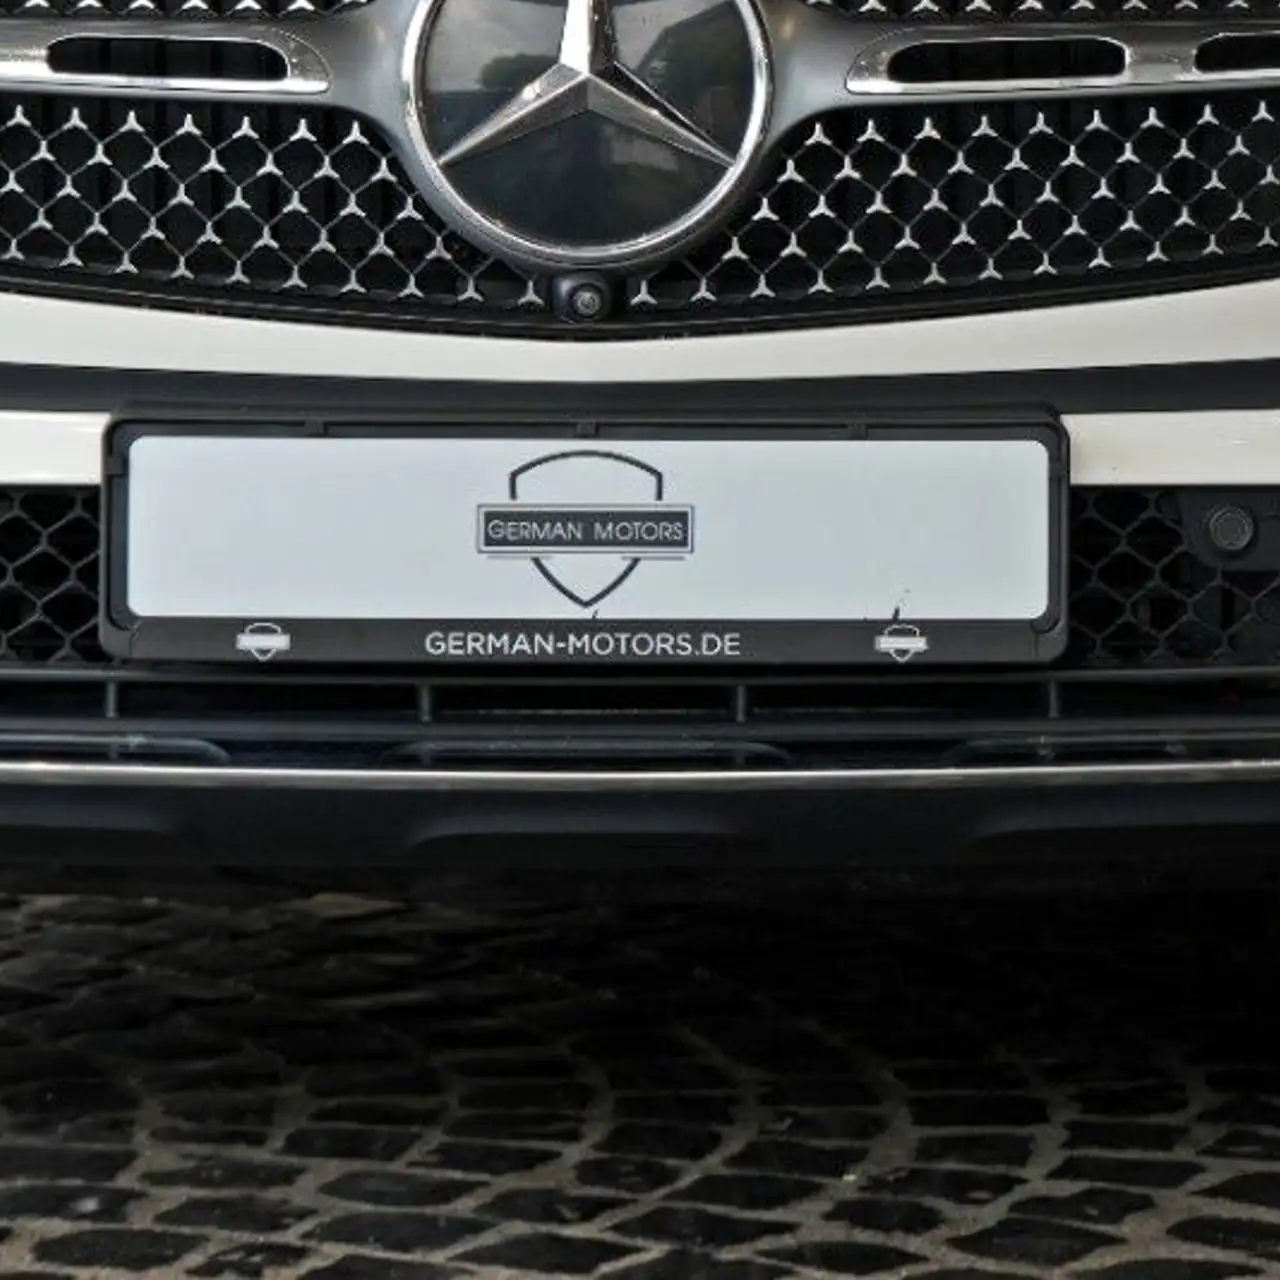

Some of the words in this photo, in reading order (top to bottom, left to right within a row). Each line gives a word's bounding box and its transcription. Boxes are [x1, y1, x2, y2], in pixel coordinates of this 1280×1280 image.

[486, 519, 583, 541] GERMAN
[593, 521, 684, 541] MOTORS
[424, 631, 741, 656] GERMAN-MOTORS.DE
